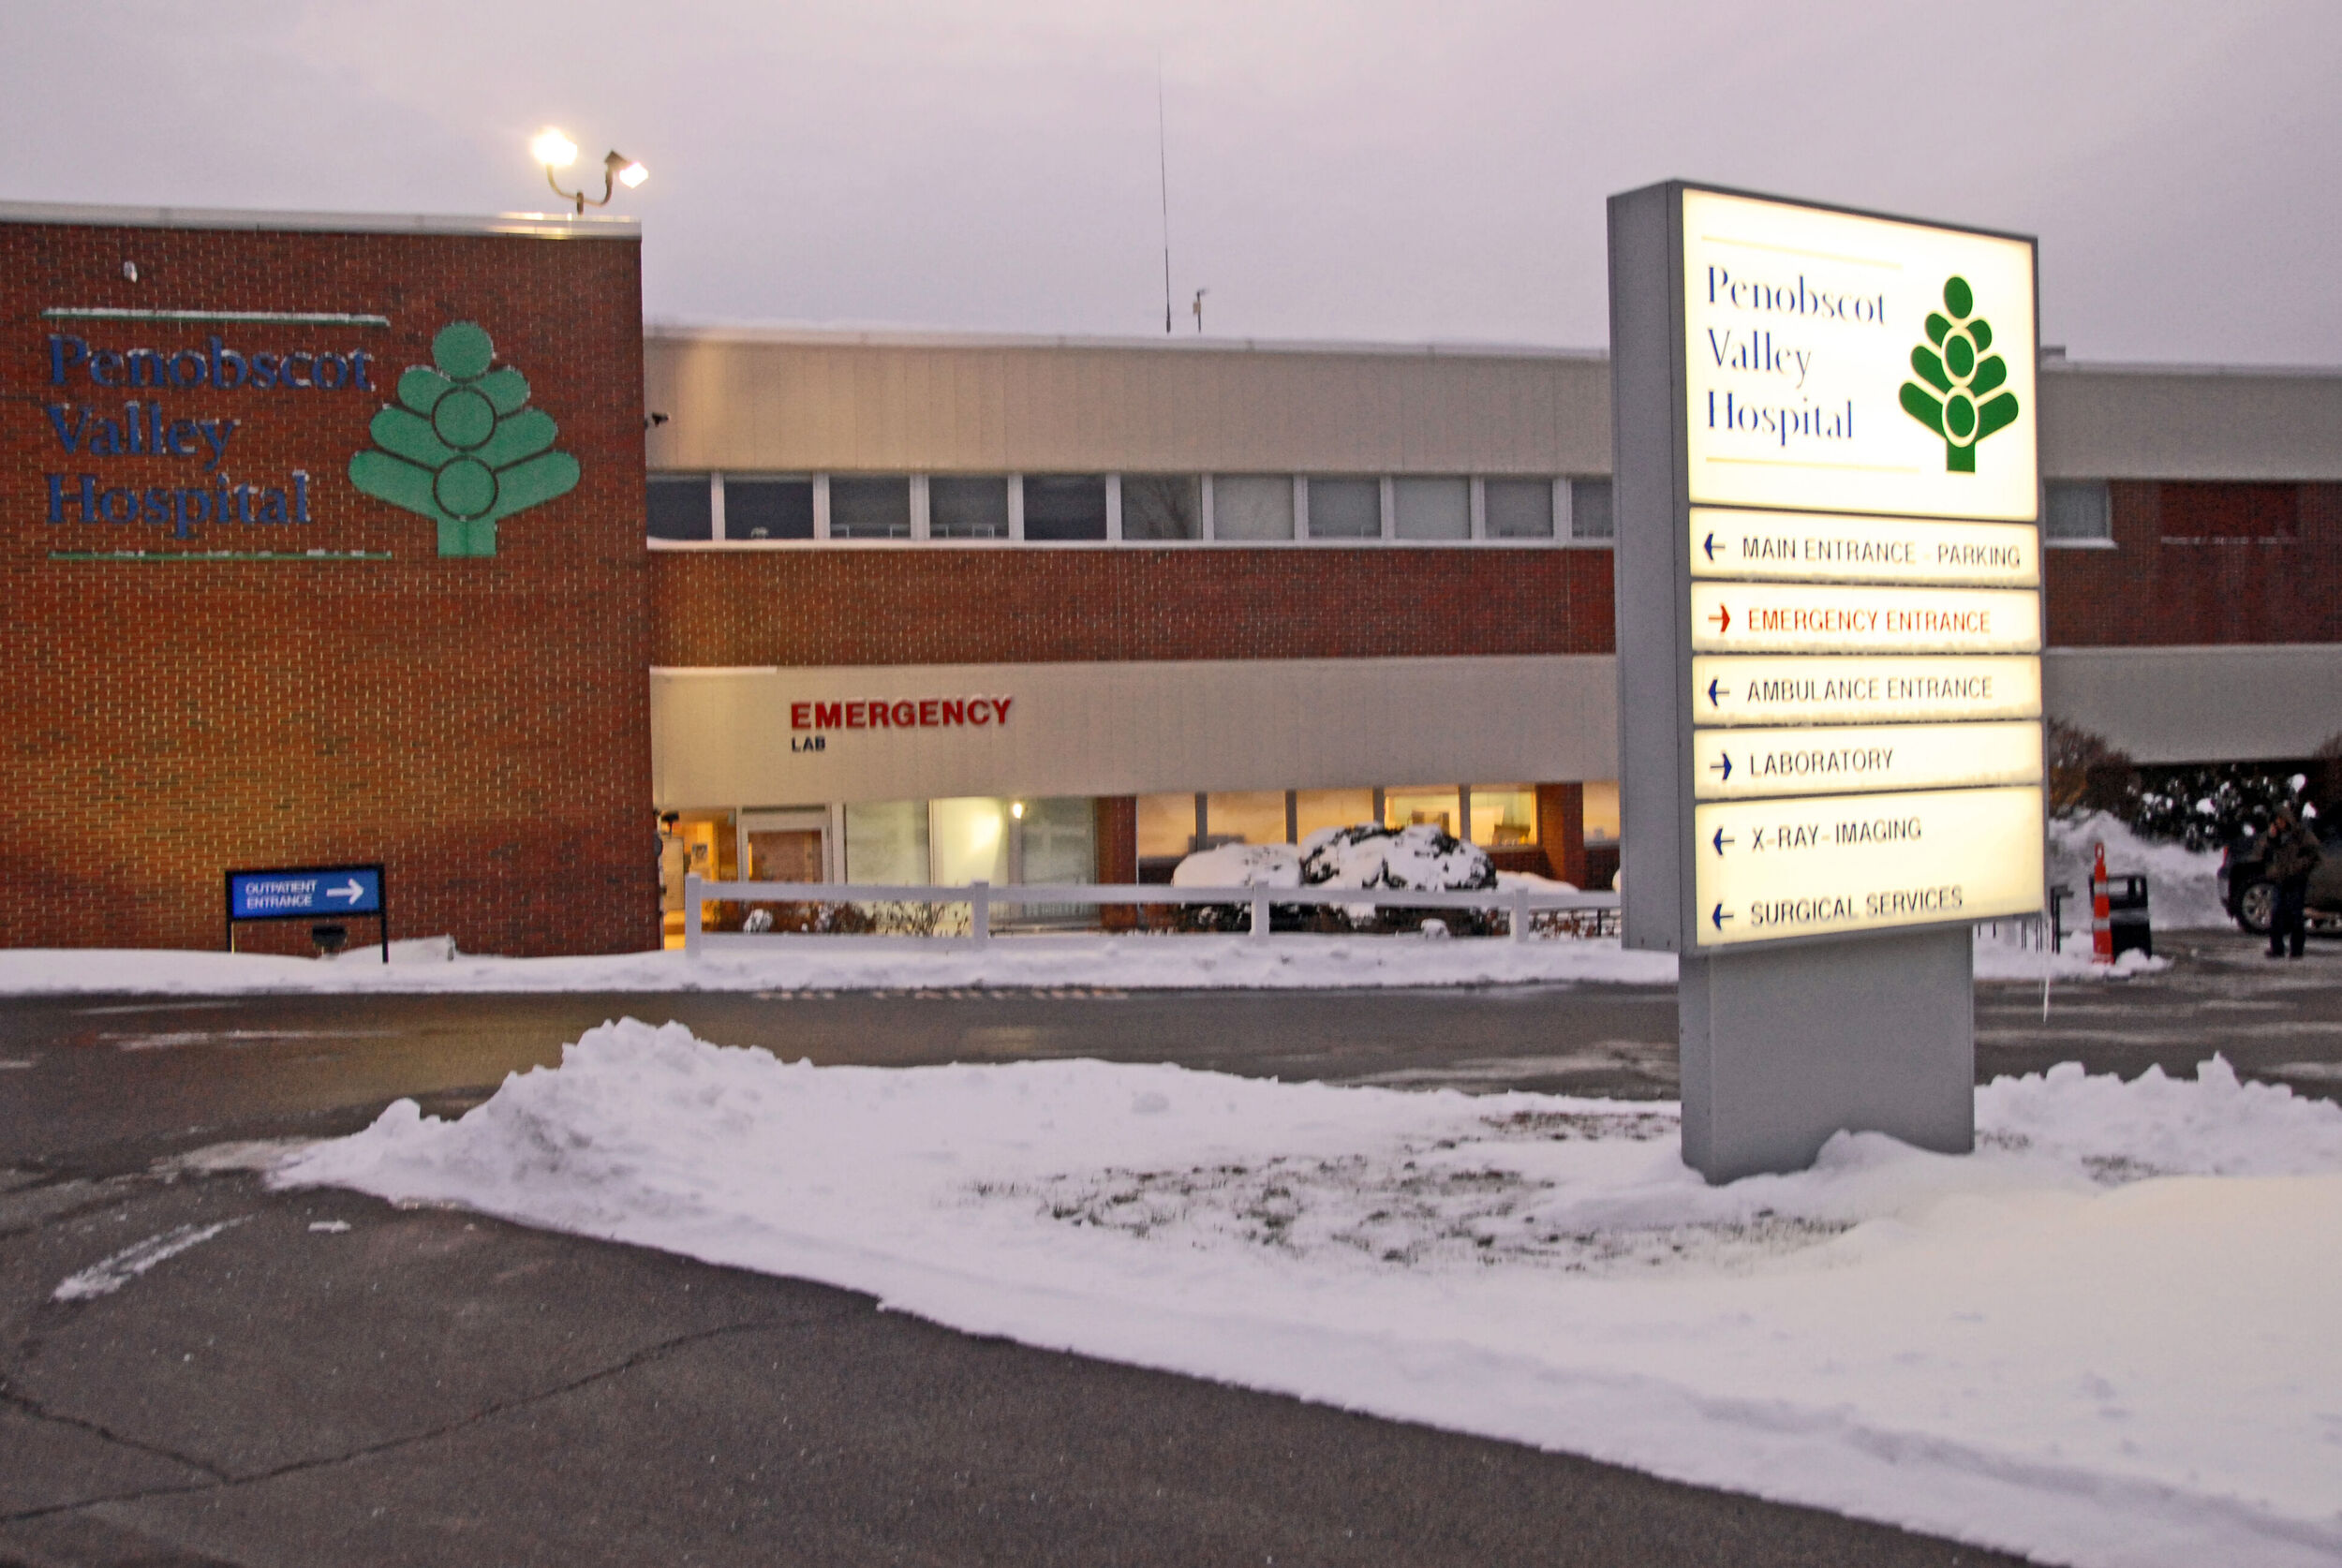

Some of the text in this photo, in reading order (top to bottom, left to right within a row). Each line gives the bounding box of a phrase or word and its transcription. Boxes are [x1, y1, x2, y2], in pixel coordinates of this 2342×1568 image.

[1708, 265, 1886, 324] Penobscot
[48, 332, 376, 392] Penobscot
[1708, 328, 1812, 390] Valley
[47, 400, 241, 470] Valley
[1708, 390, 1853, 448] Hospital
[47, 470, 312, 539] Hospital
[1742, 537, 1797, 560] MAIN
[1803, 539, 1917, 565] ENTRANCE
[1937, 543, 2022, 570] PARKING
[1748, 608, 1991, 633] EMERGENCY ENTRANCE
[1747, 676, 1994, 703] AMBULANCE ENTRANCE
[791, 698, 1012, 730] EMERGENCY
[791, 735, 826, 752] LAB
[1750, 749, 1893, 777] LABORATORY
[245, 880, 317, 895] OUTPATIENT
[246, 895, 313, 910] ENTRANCE
[1751, 884, 1964, 927] SURGICAL SERVICES
